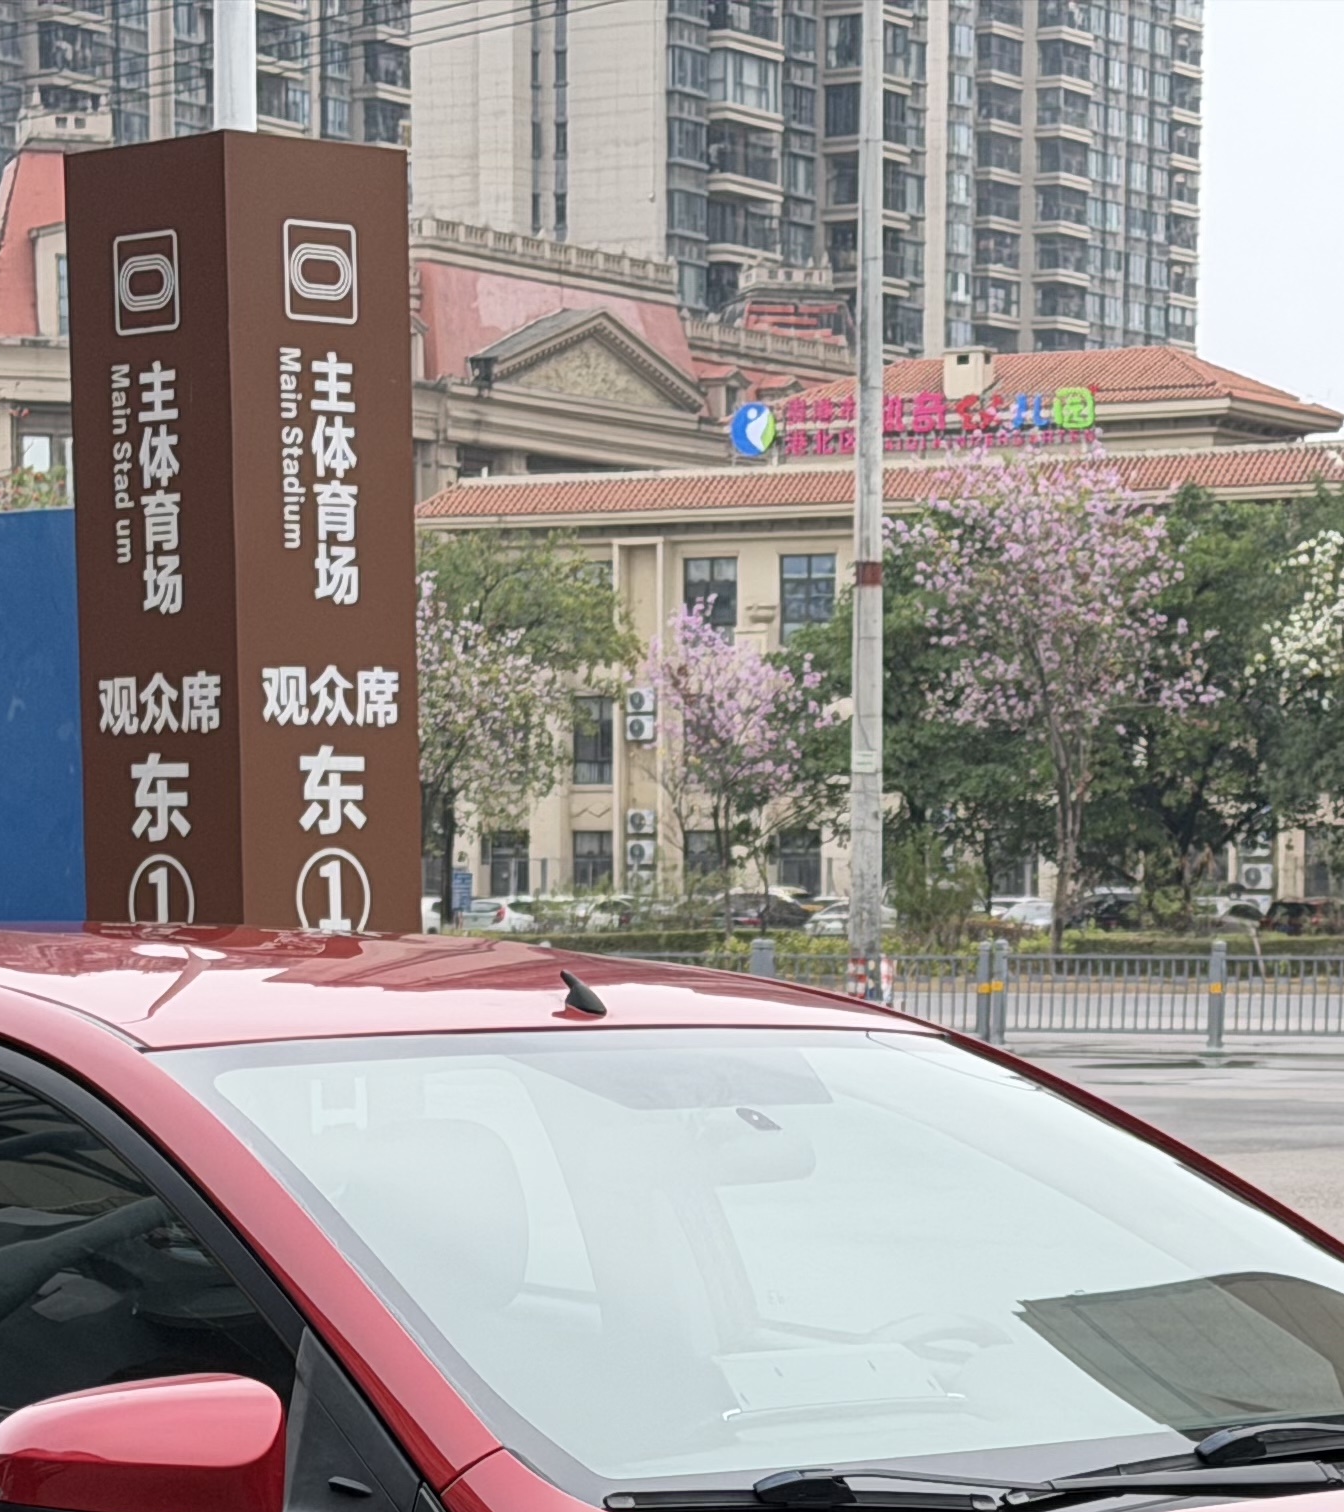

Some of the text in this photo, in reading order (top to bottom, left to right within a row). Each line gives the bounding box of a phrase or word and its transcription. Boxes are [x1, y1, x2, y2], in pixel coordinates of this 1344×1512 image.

[111, 364, 135, 564] Main Stadum
[138, 361, 183, 615] 主体育场
[279, 347, 306, 549] Main Stadium
[311, 351, 359, 605] 主体育场
[98, 670, 221, 736] 观众席
[262, 664, 399, 728] 观众席
[130, 752, 191, 842] 东
[299, 745, 367, 835] 东
